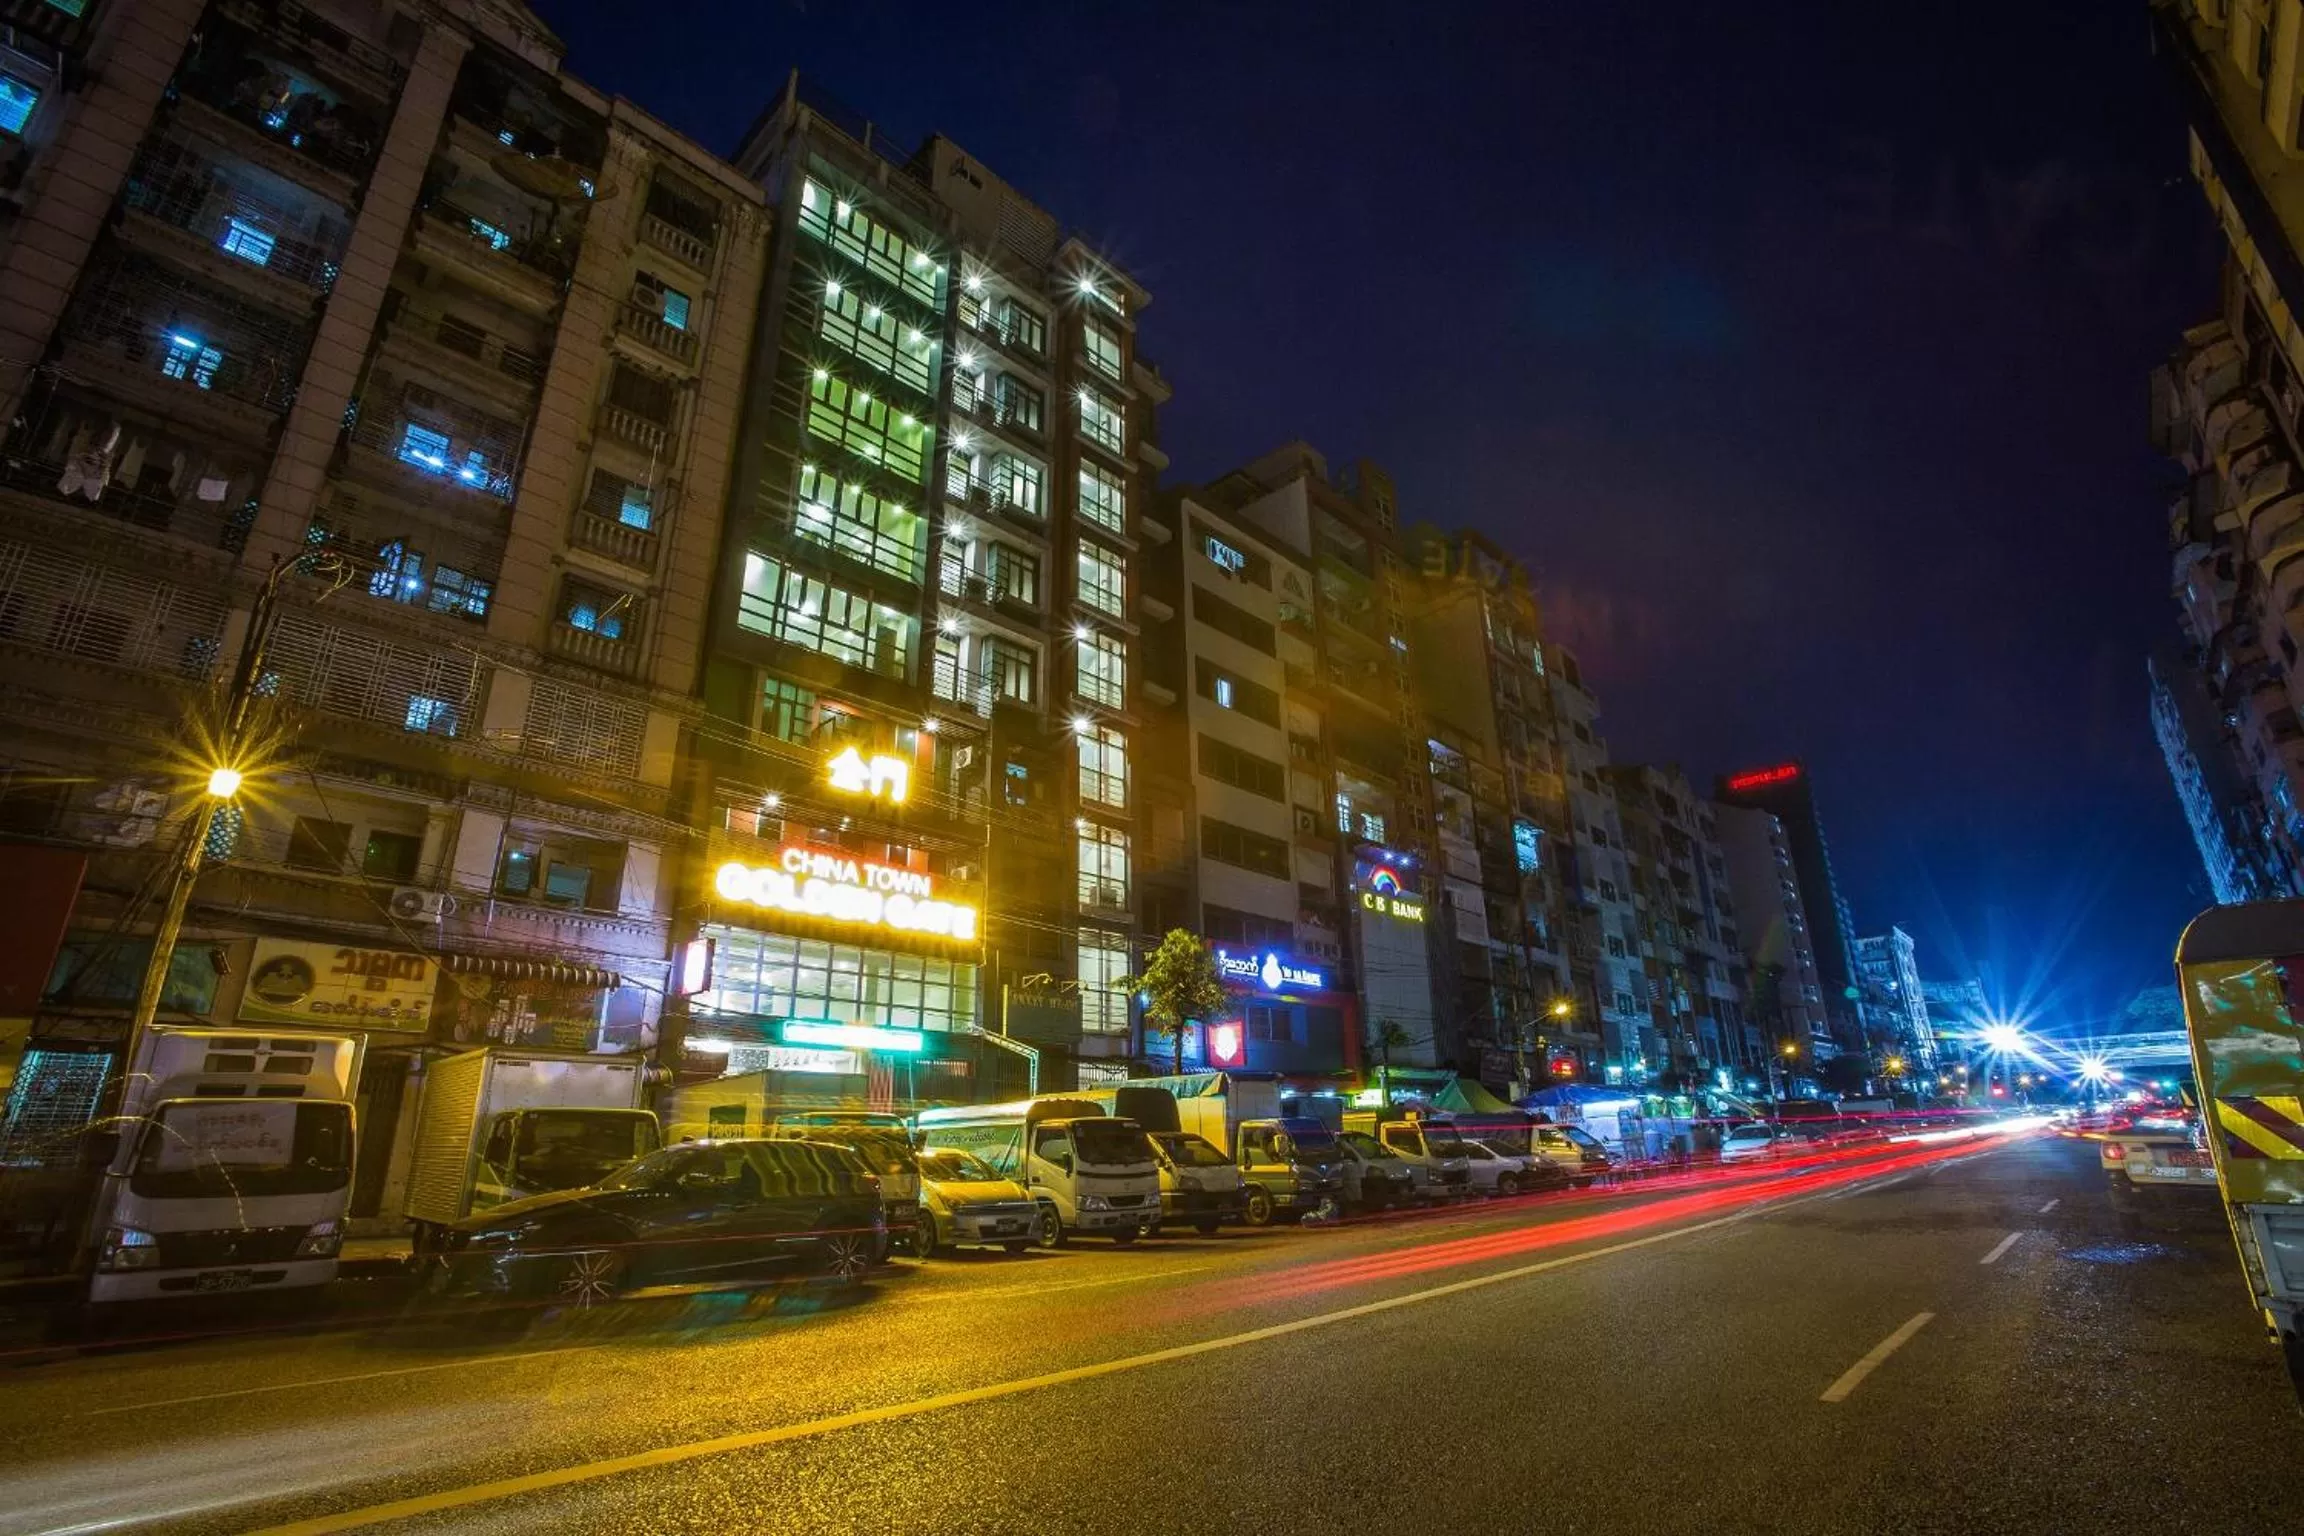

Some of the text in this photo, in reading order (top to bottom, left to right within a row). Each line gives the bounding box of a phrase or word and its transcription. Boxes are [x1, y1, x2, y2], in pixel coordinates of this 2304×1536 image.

[783, 848, 932, 897] CHINA TOWN
[1392, 900, 1423, 922] BANK
